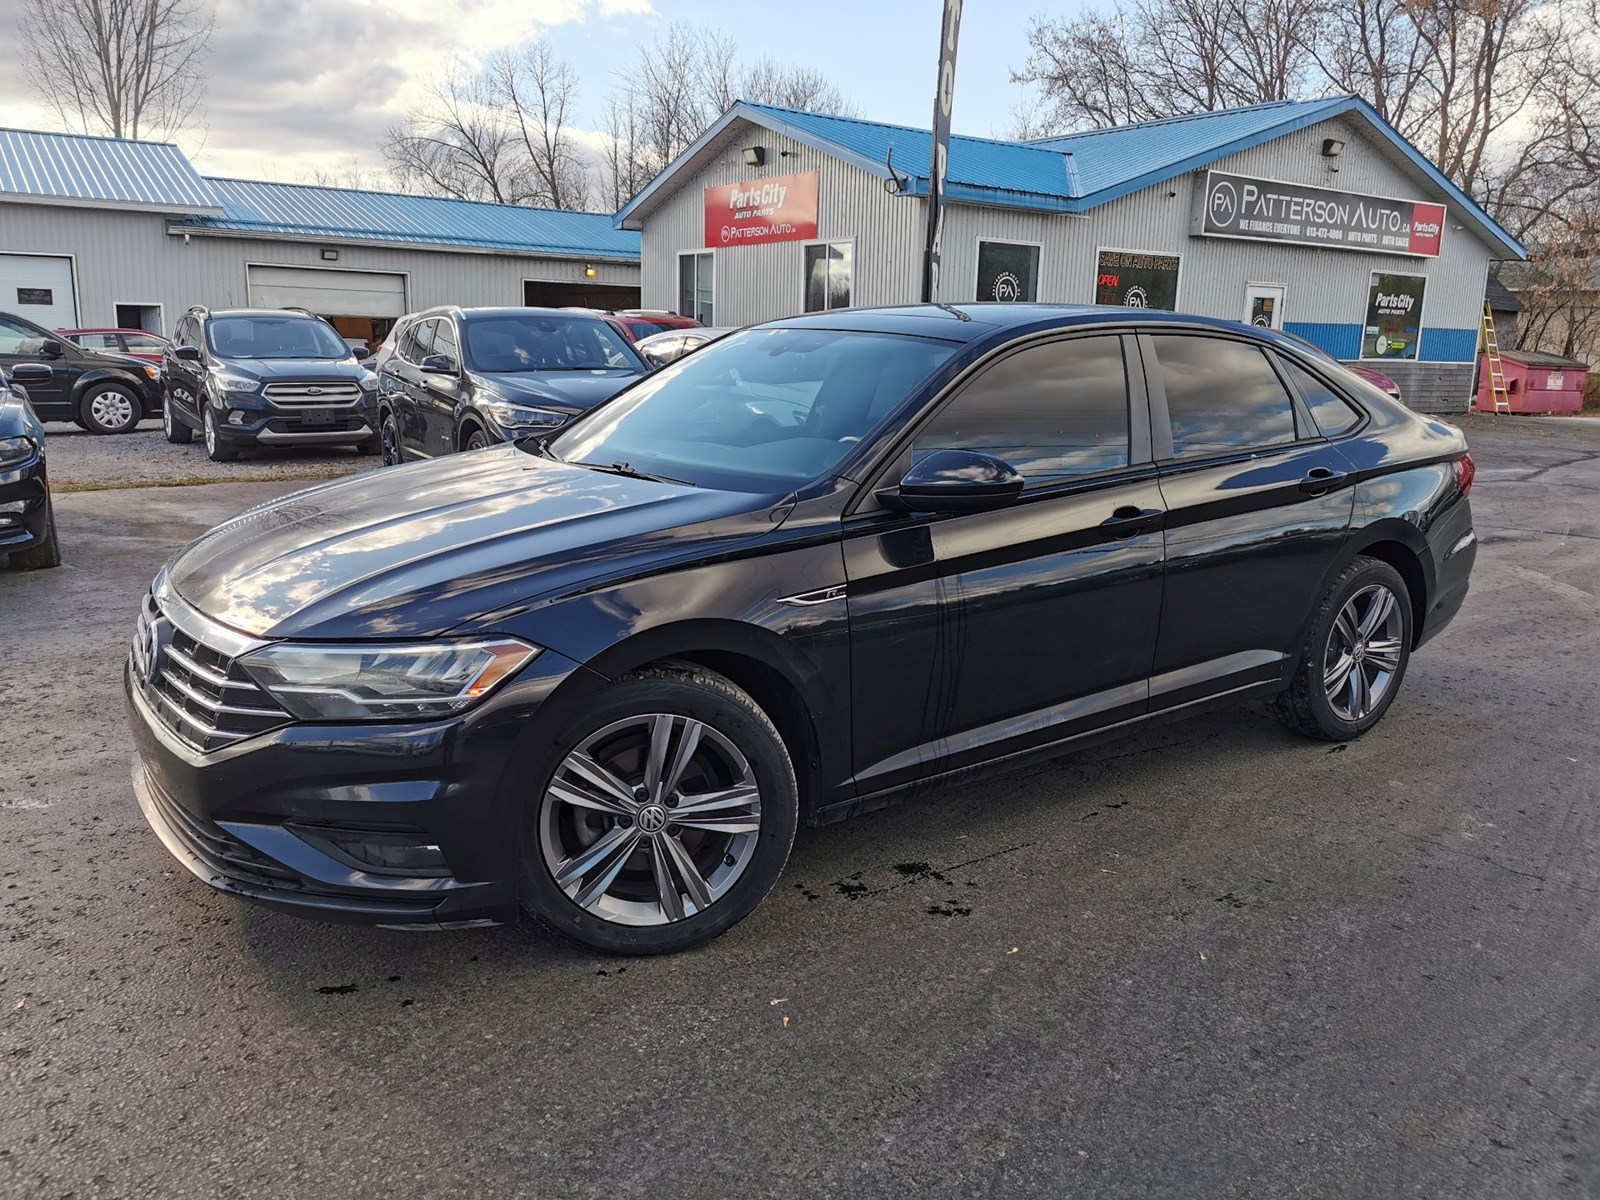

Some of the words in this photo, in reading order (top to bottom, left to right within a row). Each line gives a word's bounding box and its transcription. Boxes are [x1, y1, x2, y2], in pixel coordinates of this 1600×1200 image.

[729, 183, 787, 209] PartsCity
[1214, 193, 1232, 213] PA
[1241, 184, 1350, 225] PATTERSON
[734, 210, 751, 219] AUTO
[752, 207, 775, 217] PARTS
[731, 226, 769, 239] PATTERSON
[1239, 219, 1249, 230] WE
[1249, 220, 1273, 233] FINANCE
[1273, 222, 1301, 235] EVERYONE
[1348, 231, 1361, 242] AUTO
[1361, 233, 1378, 244] PARTS
[1382, 235, 1395, 246] AUTO
[1395, 236, 1409, 248] SALES
[1132, 254, 1153, 269] AUTO
[1154, 256, 1178, 271] PARTS
[1098, 274, 1119, 287] OPEN
[1000, 284, 1014, 297] PA
[1375, 292, 1415, 312] PartsCity
